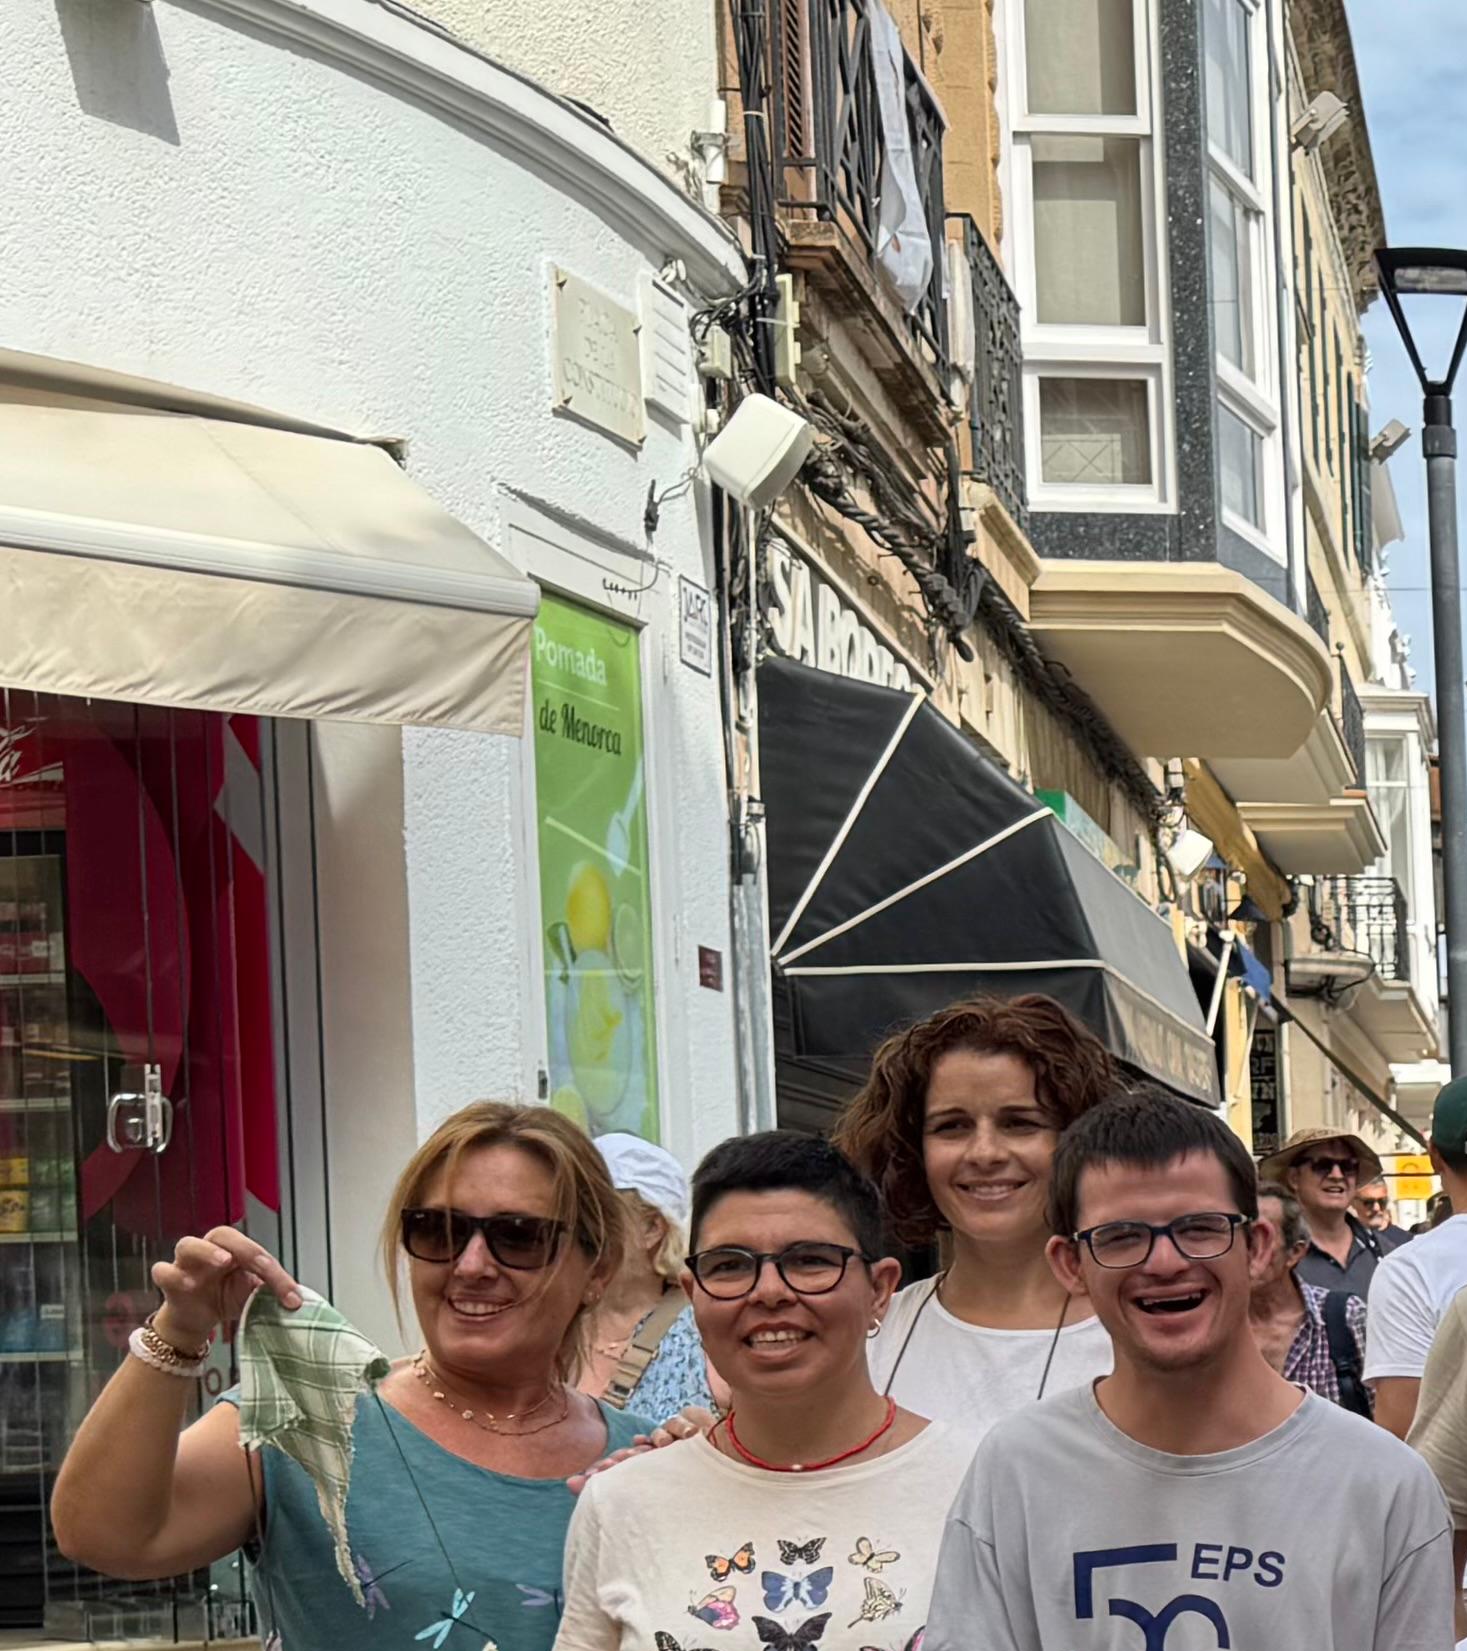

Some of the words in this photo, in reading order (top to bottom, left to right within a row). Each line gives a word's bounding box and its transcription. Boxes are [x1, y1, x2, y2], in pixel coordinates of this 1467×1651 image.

[534, 625, 607, 687] Pomada
[539, 699, 557, 734] de
[561, 704, 621, 756] Menorca
[1190, 1542, 1285, 1588] EPS
